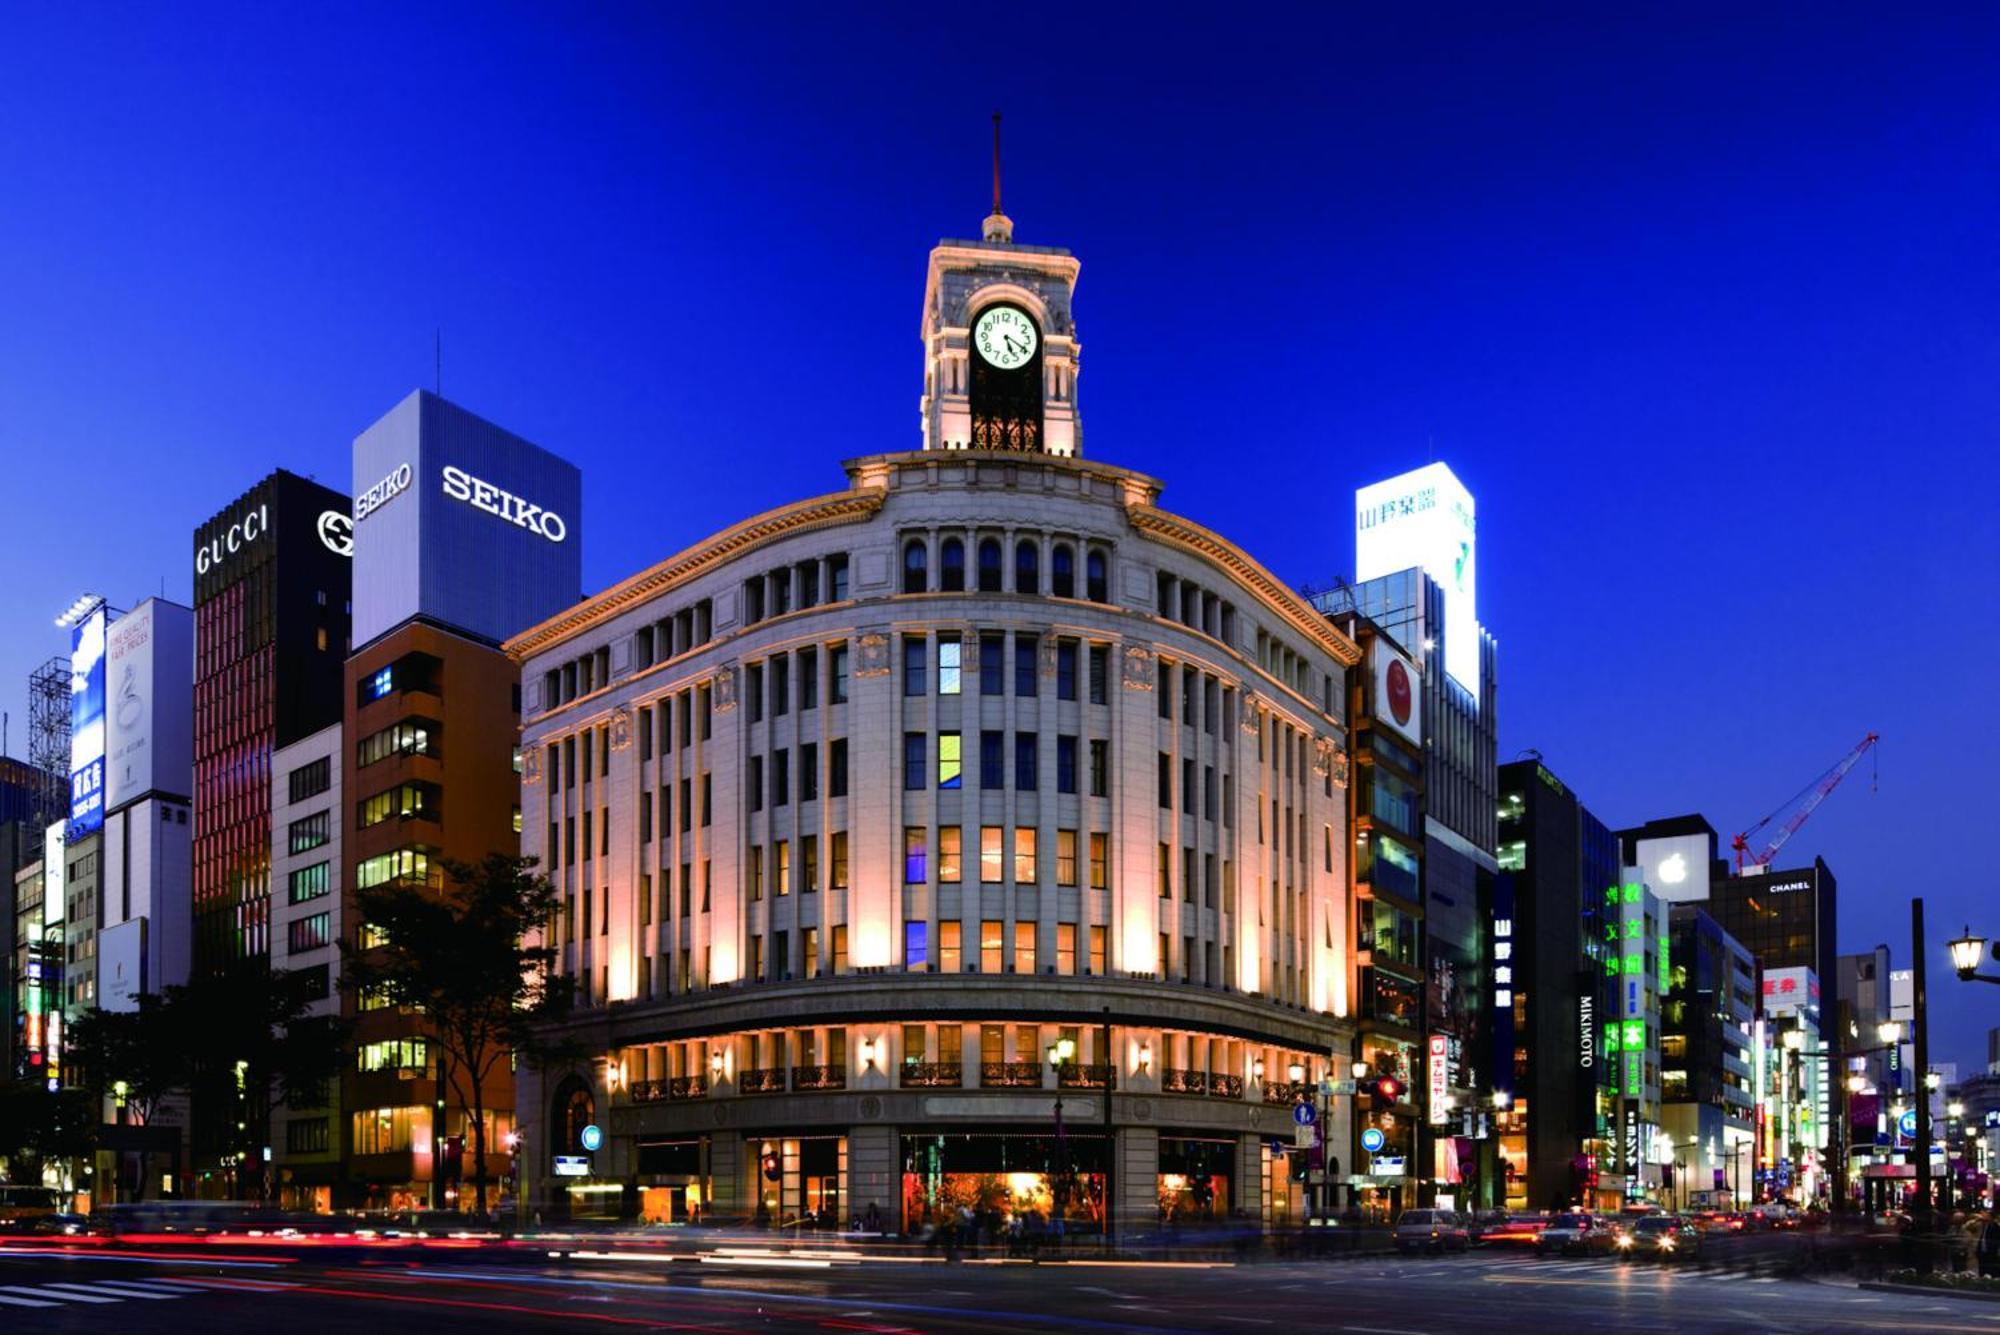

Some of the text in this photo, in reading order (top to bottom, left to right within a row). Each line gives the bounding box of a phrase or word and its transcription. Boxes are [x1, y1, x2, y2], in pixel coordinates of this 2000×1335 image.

[992, 314, 1000, 324] 11
[1002, 312, 1011, 323] 12
[983, 322, 993, 332] 10
[1020, 323, 1028, 334] 2
[980, 331, 989, 342] 9
[1023, 335, 1032, 345] 3
[984, 342, 992, 353] 8
[993, 350, 1001, 361] 7
[1001, 353, 1010, 365] 6
[356, 464, 411, 521] SEIKO
[442, 465, 566, 542] SEIKO
[196, 504, 267, 574] GUCCI
[1769, 880, 1811, 893] CHANEL
[1580, 996, 1593, 1068] MIKIMOTO
